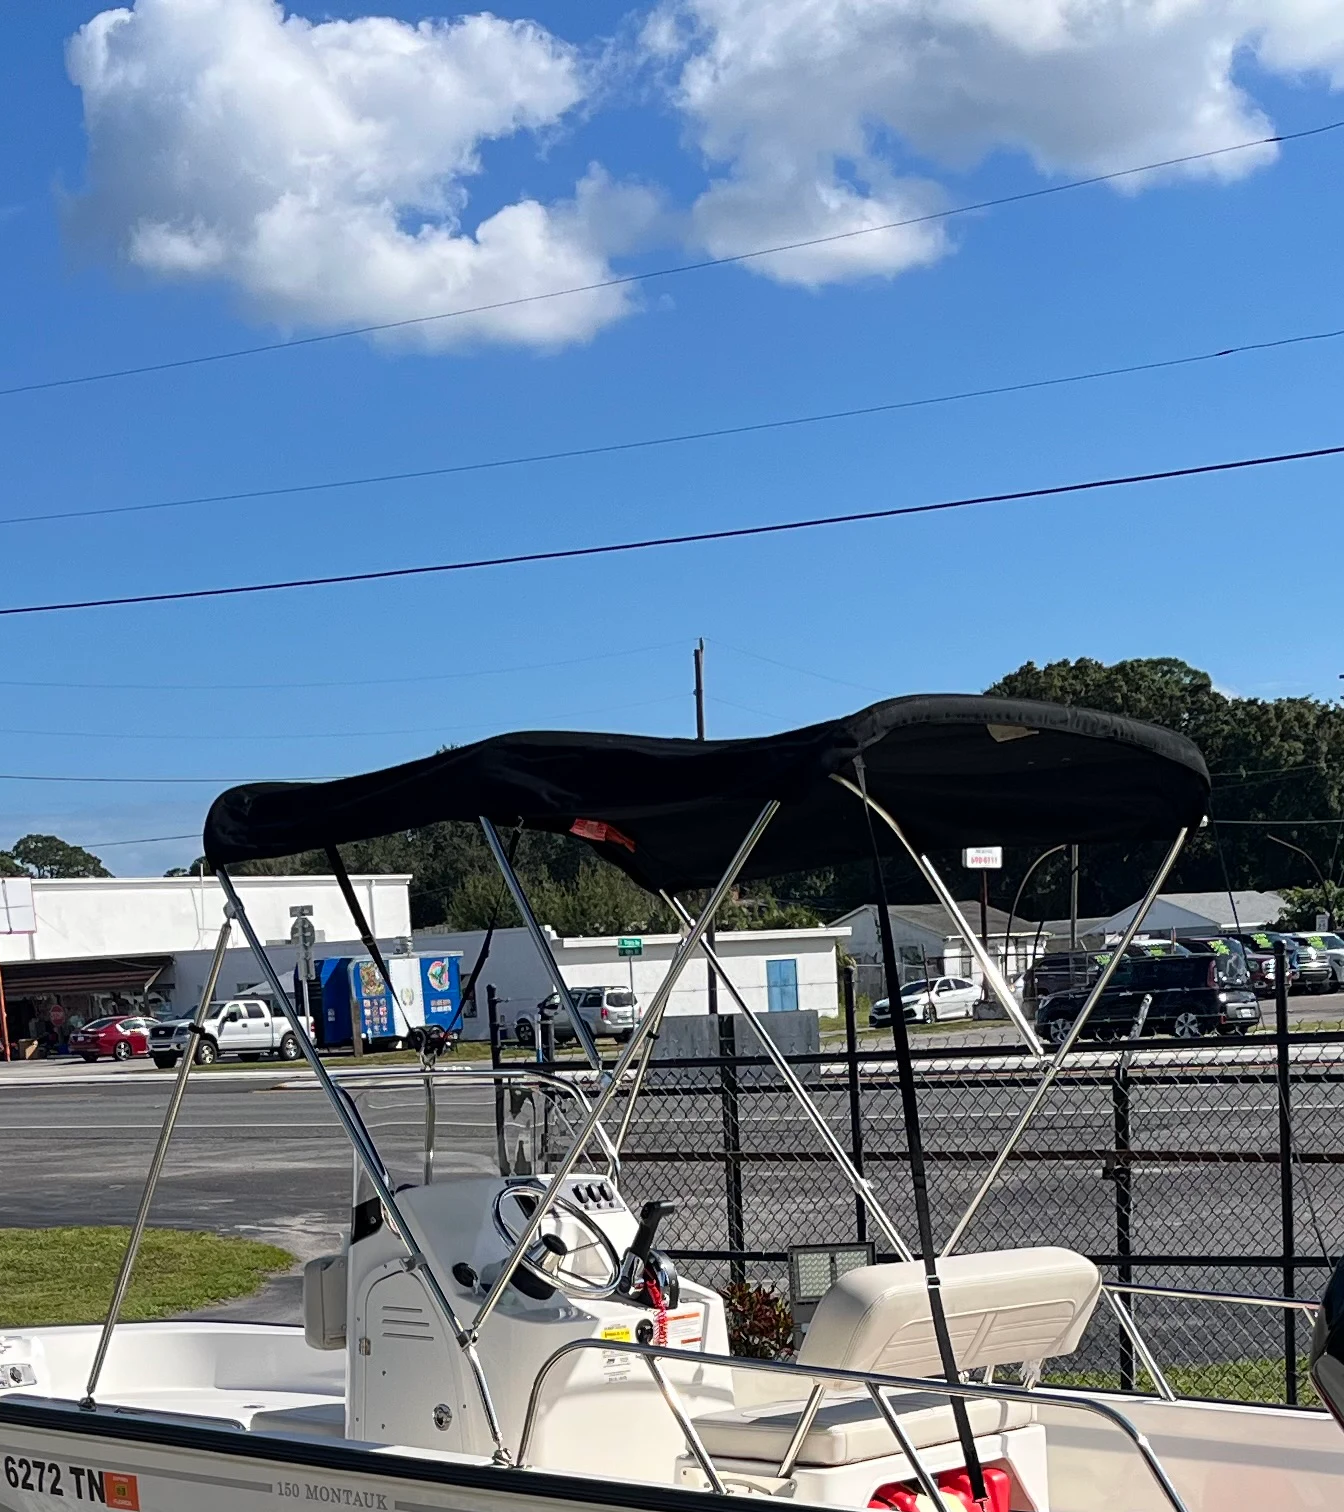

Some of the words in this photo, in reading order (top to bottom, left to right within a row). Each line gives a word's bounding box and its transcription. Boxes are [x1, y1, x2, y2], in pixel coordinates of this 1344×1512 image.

[4, 1455, 64, 1496] 6272
[69, 1465, 106, 1503] TN
[277, 1481, 300, 1498] 150
[305, 1484, 388, 1511] MONTAUK
